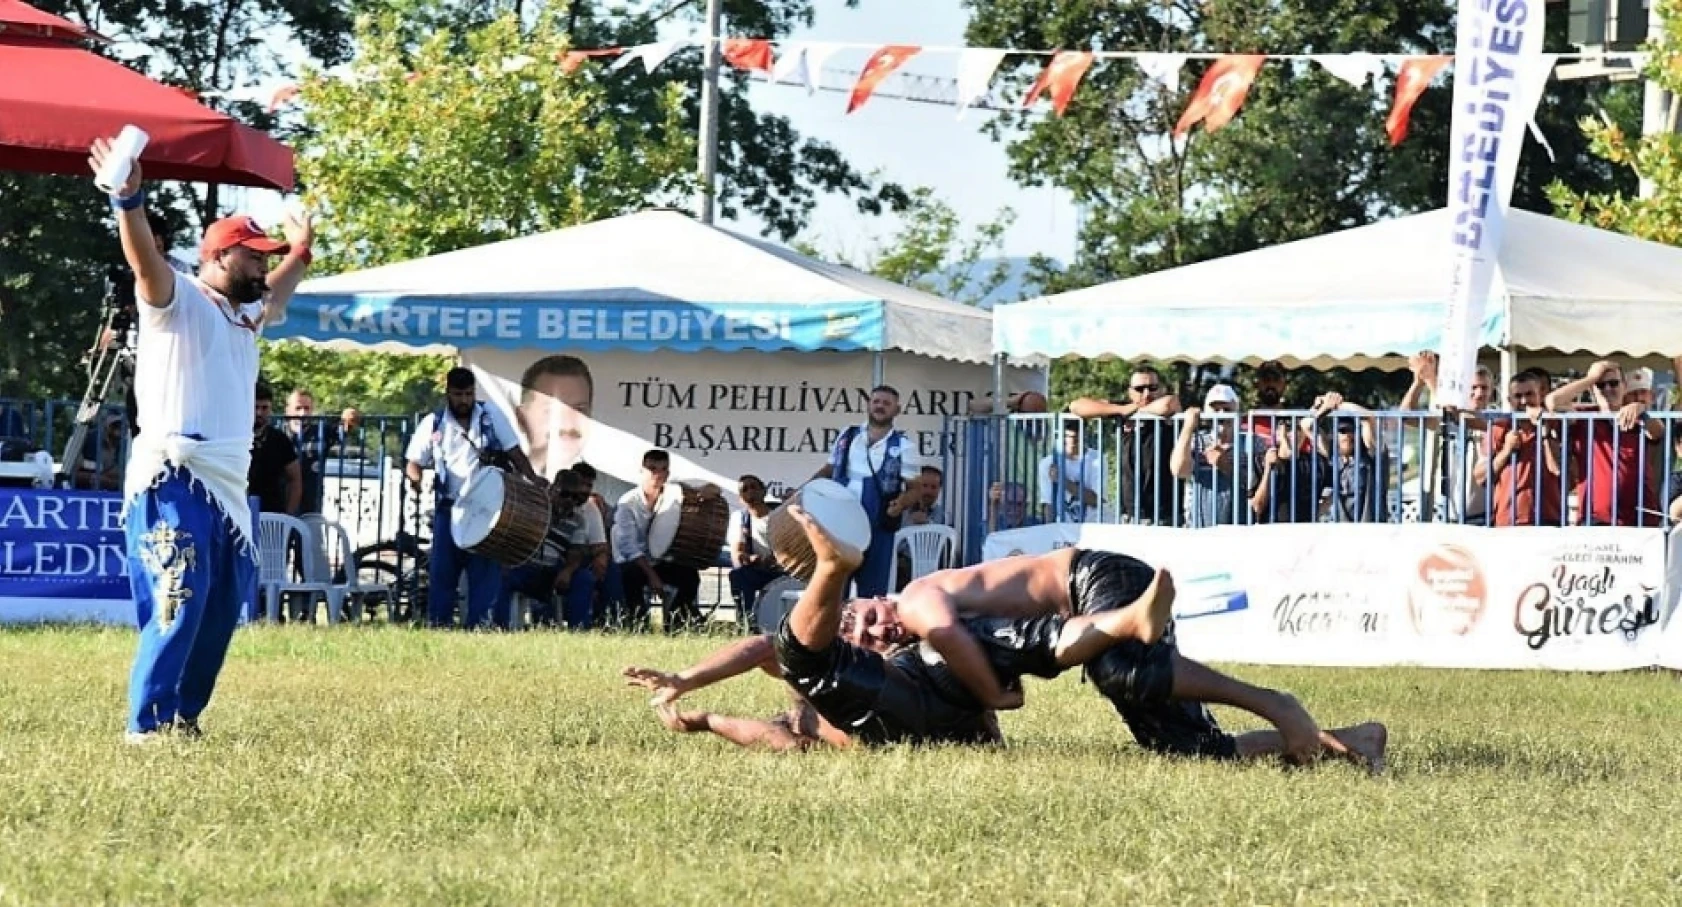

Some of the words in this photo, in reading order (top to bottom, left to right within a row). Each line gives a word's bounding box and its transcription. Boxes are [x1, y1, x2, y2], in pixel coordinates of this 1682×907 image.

[317, 303, 523, 339] KARTEPE
[618, 377, 697, 409] TÜM
[0, 496, 123, 530] ARTE
